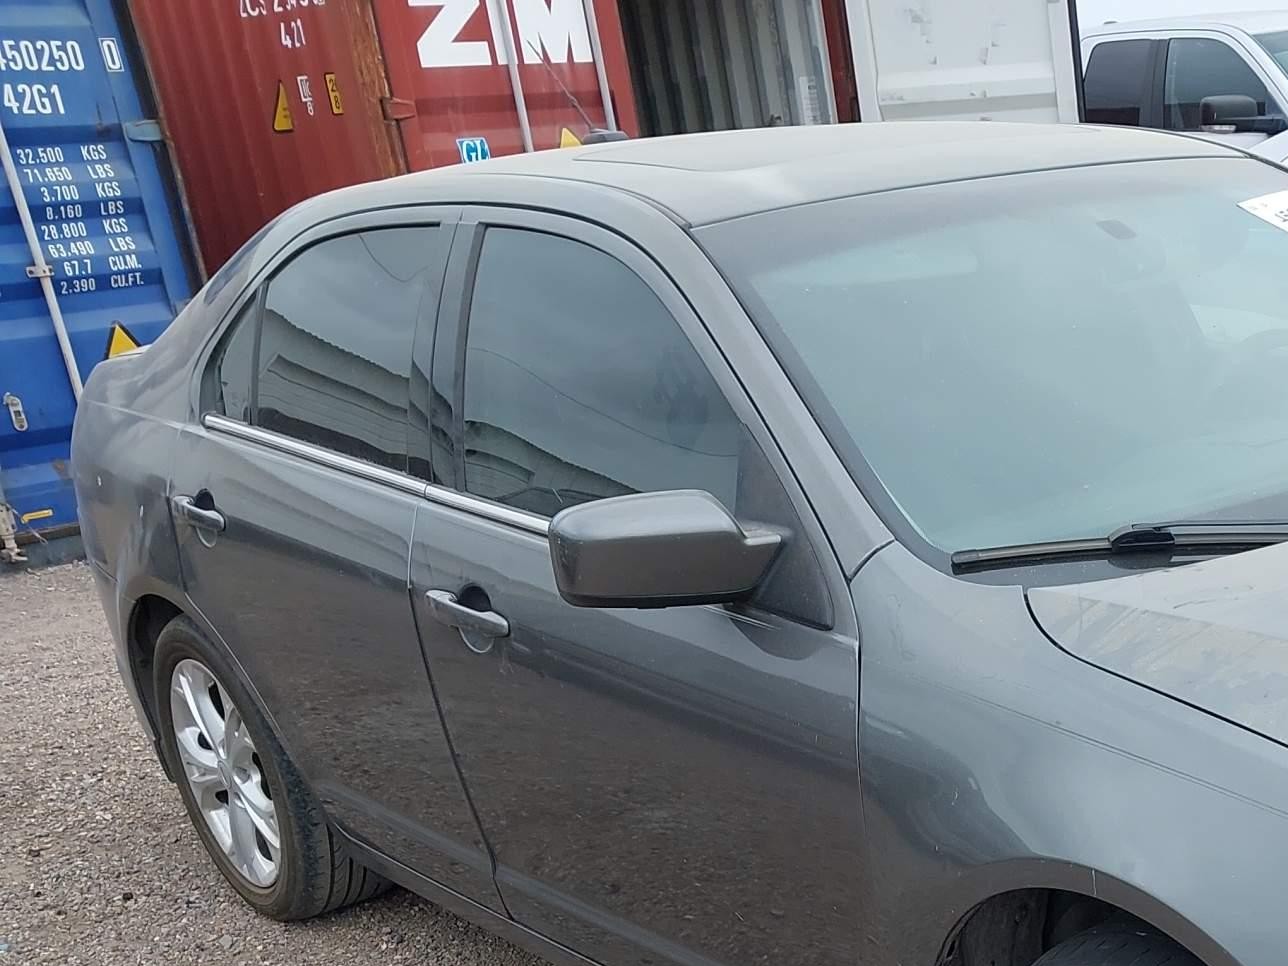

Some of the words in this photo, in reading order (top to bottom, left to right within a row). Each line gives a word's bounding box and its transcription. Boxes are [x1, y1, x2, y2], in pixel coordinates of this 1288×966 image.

[3, 84, 65, 114] 42G1
[16, 147, 64, 164] 32.500
[81, 144, 107, 161] KGS
[24, 166, 73, 183] 71.650
[87, 164, 115, 179] LBS
[41, 185, 80, 202] 3.700
[95, 181, 121, 198] KGS
[46, 204, 83, 220] 8.160
[100, 201, 125, 216] LBS
[41, 222, 87, 241] 28.800
[102, 218, 129, 235] KGS
[48, 240, 95, 258] 63.490
[109, 236, 136, 252] LBS
[63, 259, 92, 277] 67.7
[60, 278, 96, 295] 2.390
[110, 272, 145, 288] CU.FT.
